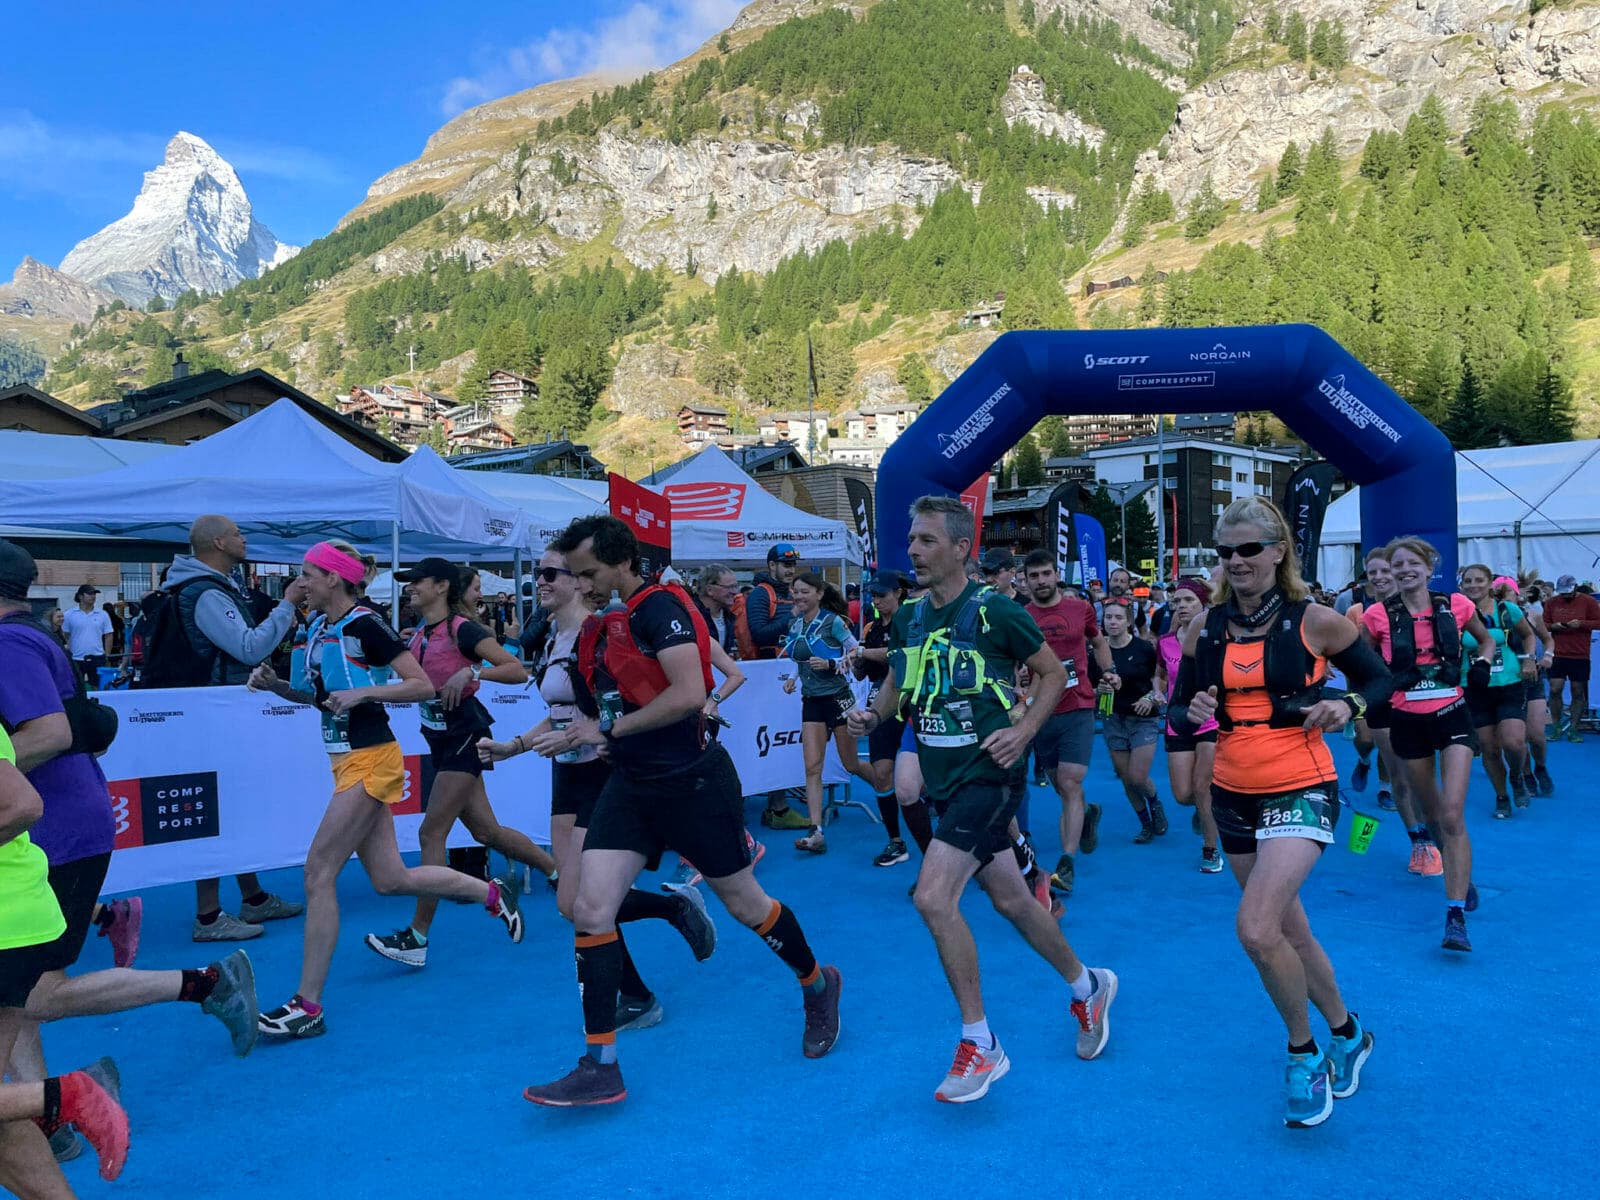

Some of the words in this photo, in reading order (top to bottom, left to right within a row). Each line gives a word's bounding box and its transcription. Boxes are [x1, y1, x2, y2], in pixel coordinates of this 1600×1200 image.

[1095, 355, 1150, 365] SCOTT
[1190, 350, 1251, 361] NORQAIN
[1135, 376, 1209, 386] COMPRESSPORT
[1319, 379, 1370, 429] ULTRAKS
[950, 382, 1012, 442] MATTERHORN
[1337, 386, 1402, 443] MATTERHORN
[942, 413, 994, 459] ULTRAKS
[919, 718, 947, 733] 1233
[772, 730, 803, 747] SC
[156, 786, 204, 799] COMP
[158, 801, 204, 815] RESS
[159, 816, 204, 830] PORT
[1263, 809, 1303, 826] 1282
